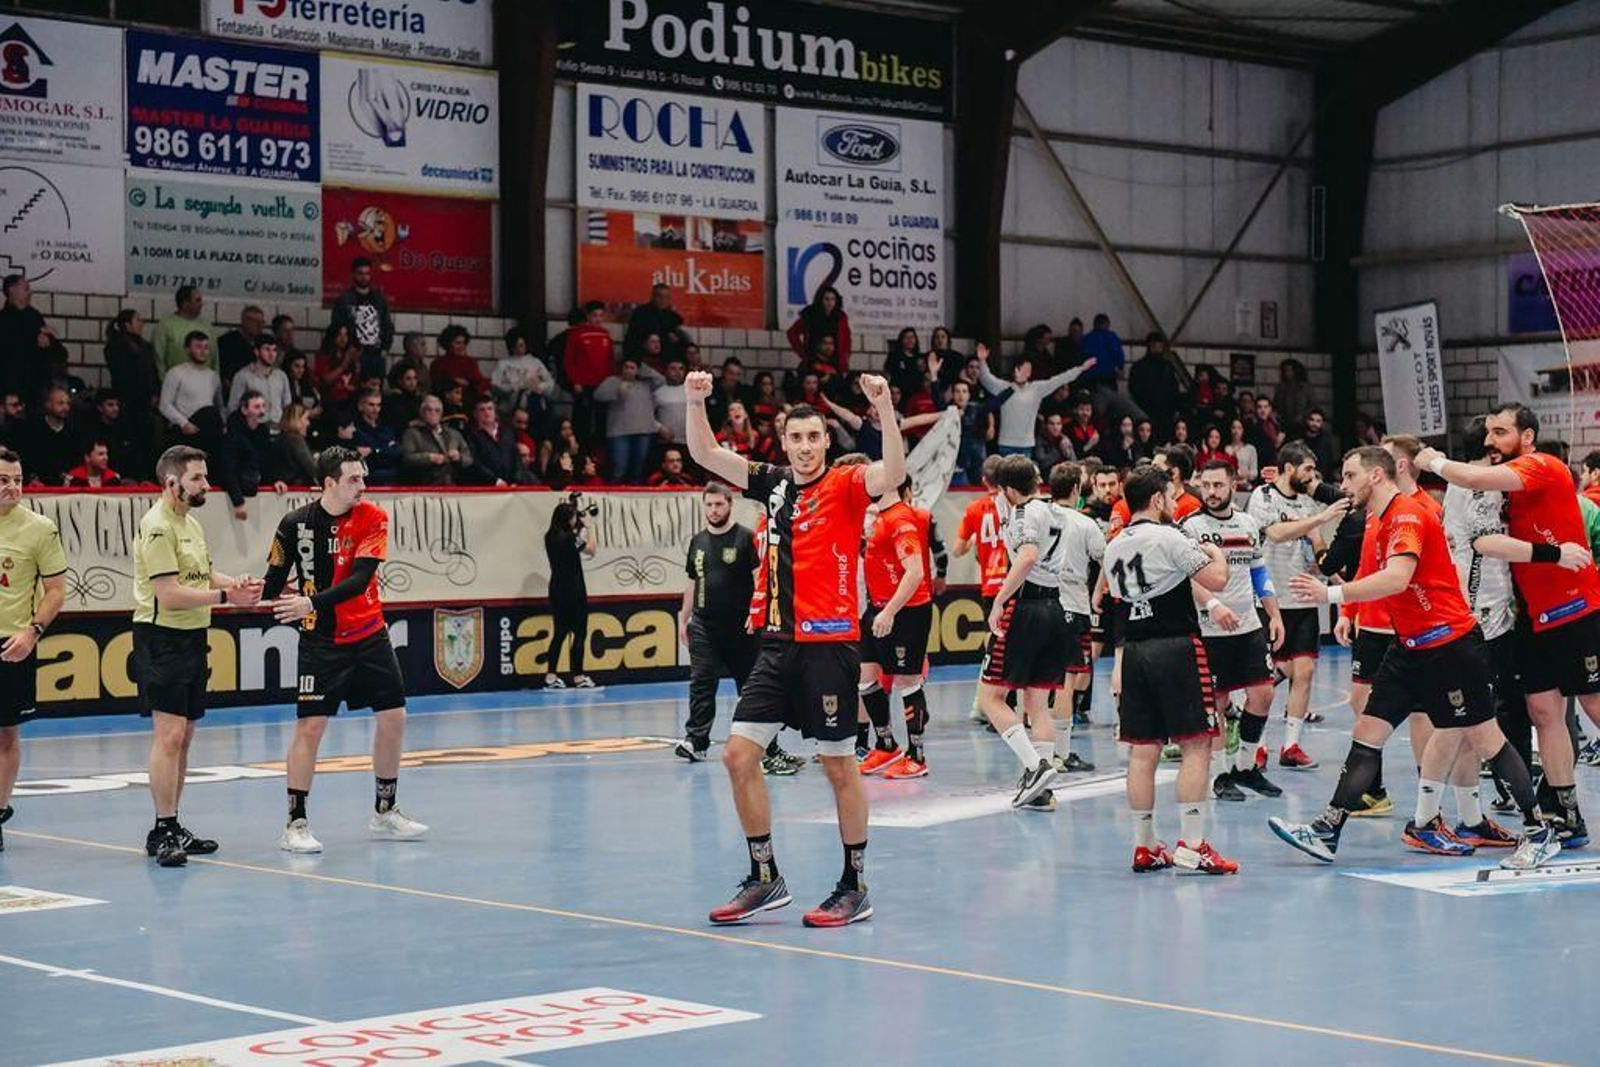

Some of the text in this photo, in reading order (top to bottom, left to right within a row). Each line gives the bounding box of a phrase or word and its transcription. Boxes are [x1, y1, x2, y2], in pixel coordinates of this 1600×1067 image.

[604, 0, 942, 89] Podium bikes
[137, 49, 310, 101] MASTER
[0, 97, 80, 118] MOGAR,
[415, 97, 489, 124] VIDRIO
[588, 93, 754, 154] ROCHA
[134, 126, 190, 158] 986
[198, 132, 248, 164] 611
[259, 138, 311, 170] 973
[836, 131, 885, 161] Ford
[588, 153, 649, 174] SUMINISTROS
[650, 159, 674, 175] PARA
[676, 160, 688, 177] LA
[785, 168, 843, 186] Autocar
[847, 174, 865, 188] La
[909, 179, 936, 194] S.L.
[155, 186, 295, 219] La segunda vuelta
[888, 214, 899, 228] LA
[54, 251, 93, 262] ROSAL
[130, 247, 319, 268] A 100M DE LA PLAZA DEL CALVARIO
[847, 236, 936, 263] cociñas
[848, 263, 937, 291] e baños
[1425, 352, 1438, 382] SPORT
[1413, 350, 1428, 432] PEUGEOT
[1429, 383, 1443, 430] TALLERES
[1041, 527, 1061, 562] 7
[1111, 552, 1147, 598] 11
[500, 616, 514, 676] grupo
[299, 675, 315, 693] 10
[249, 993, 647, 1057] CONCELLO
[304, 1003, 723, 1067] DO ROSAL
